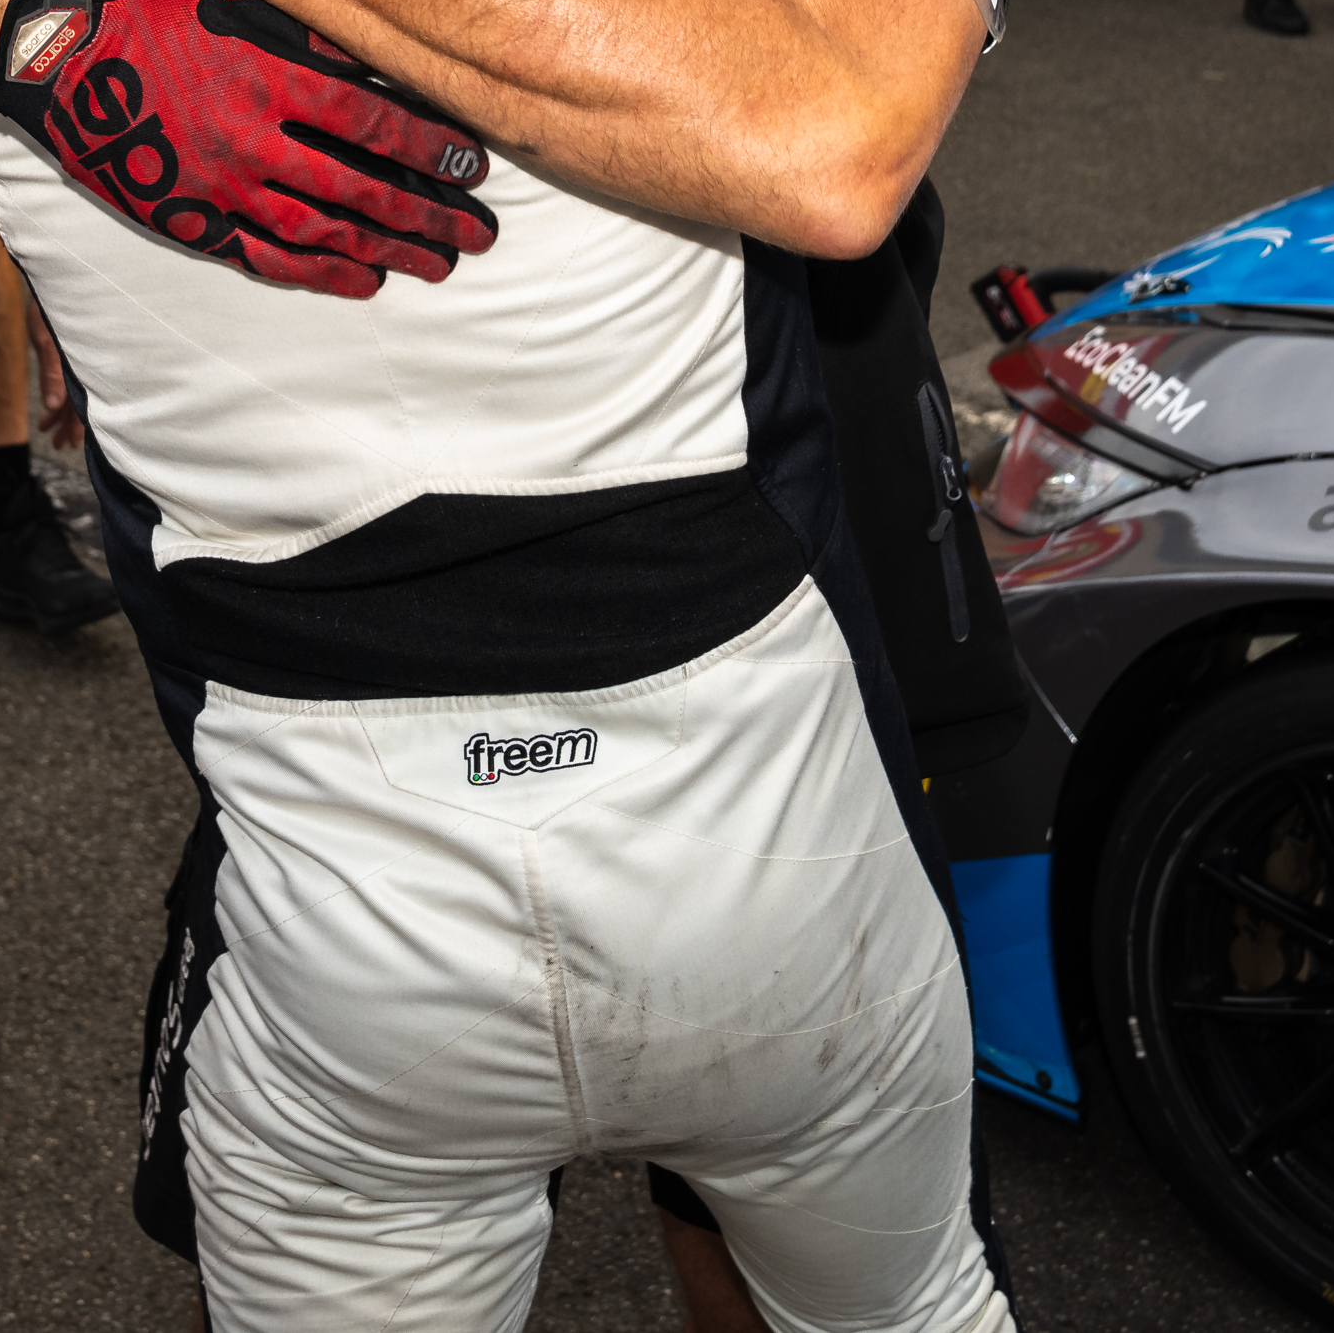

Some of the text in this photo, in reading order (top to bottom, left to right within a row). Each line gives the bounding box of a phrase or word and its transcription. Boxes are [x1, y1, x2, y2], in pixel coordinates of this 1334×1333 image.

[21, 23, 54, 57] sparco
[30, 25, 75, 72] sparco
[1063, 324, 1208, 435] EcoCleanFM
[464, 727, 598, 786] freem
